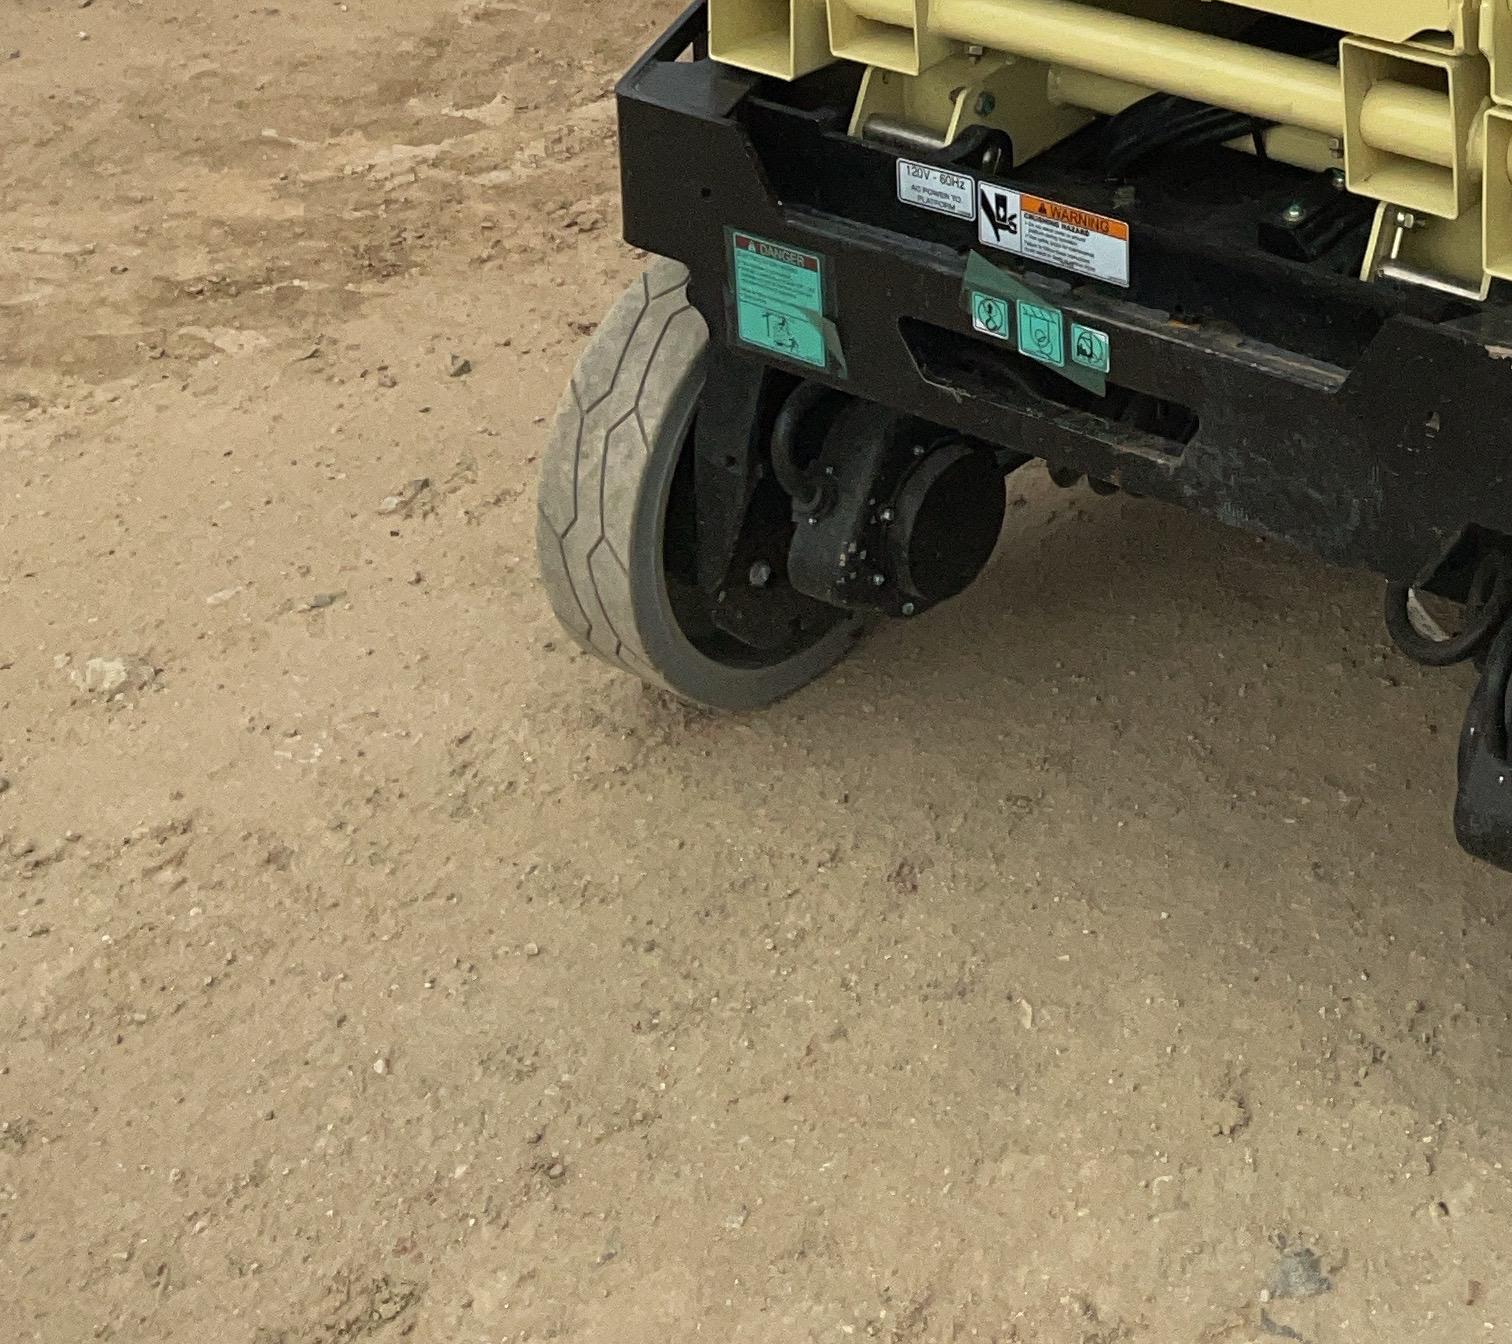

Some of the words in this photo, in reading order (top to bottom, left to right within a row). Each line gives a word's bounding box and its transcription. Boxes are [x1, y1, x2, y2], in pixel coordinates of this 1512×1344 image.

[906, 164, 931, 180] 120V
[939, 173, 966, 191] 60Hz
[1050, 205, 1110, 234] WARNING
[760, 244, 805, 268] DANGER
